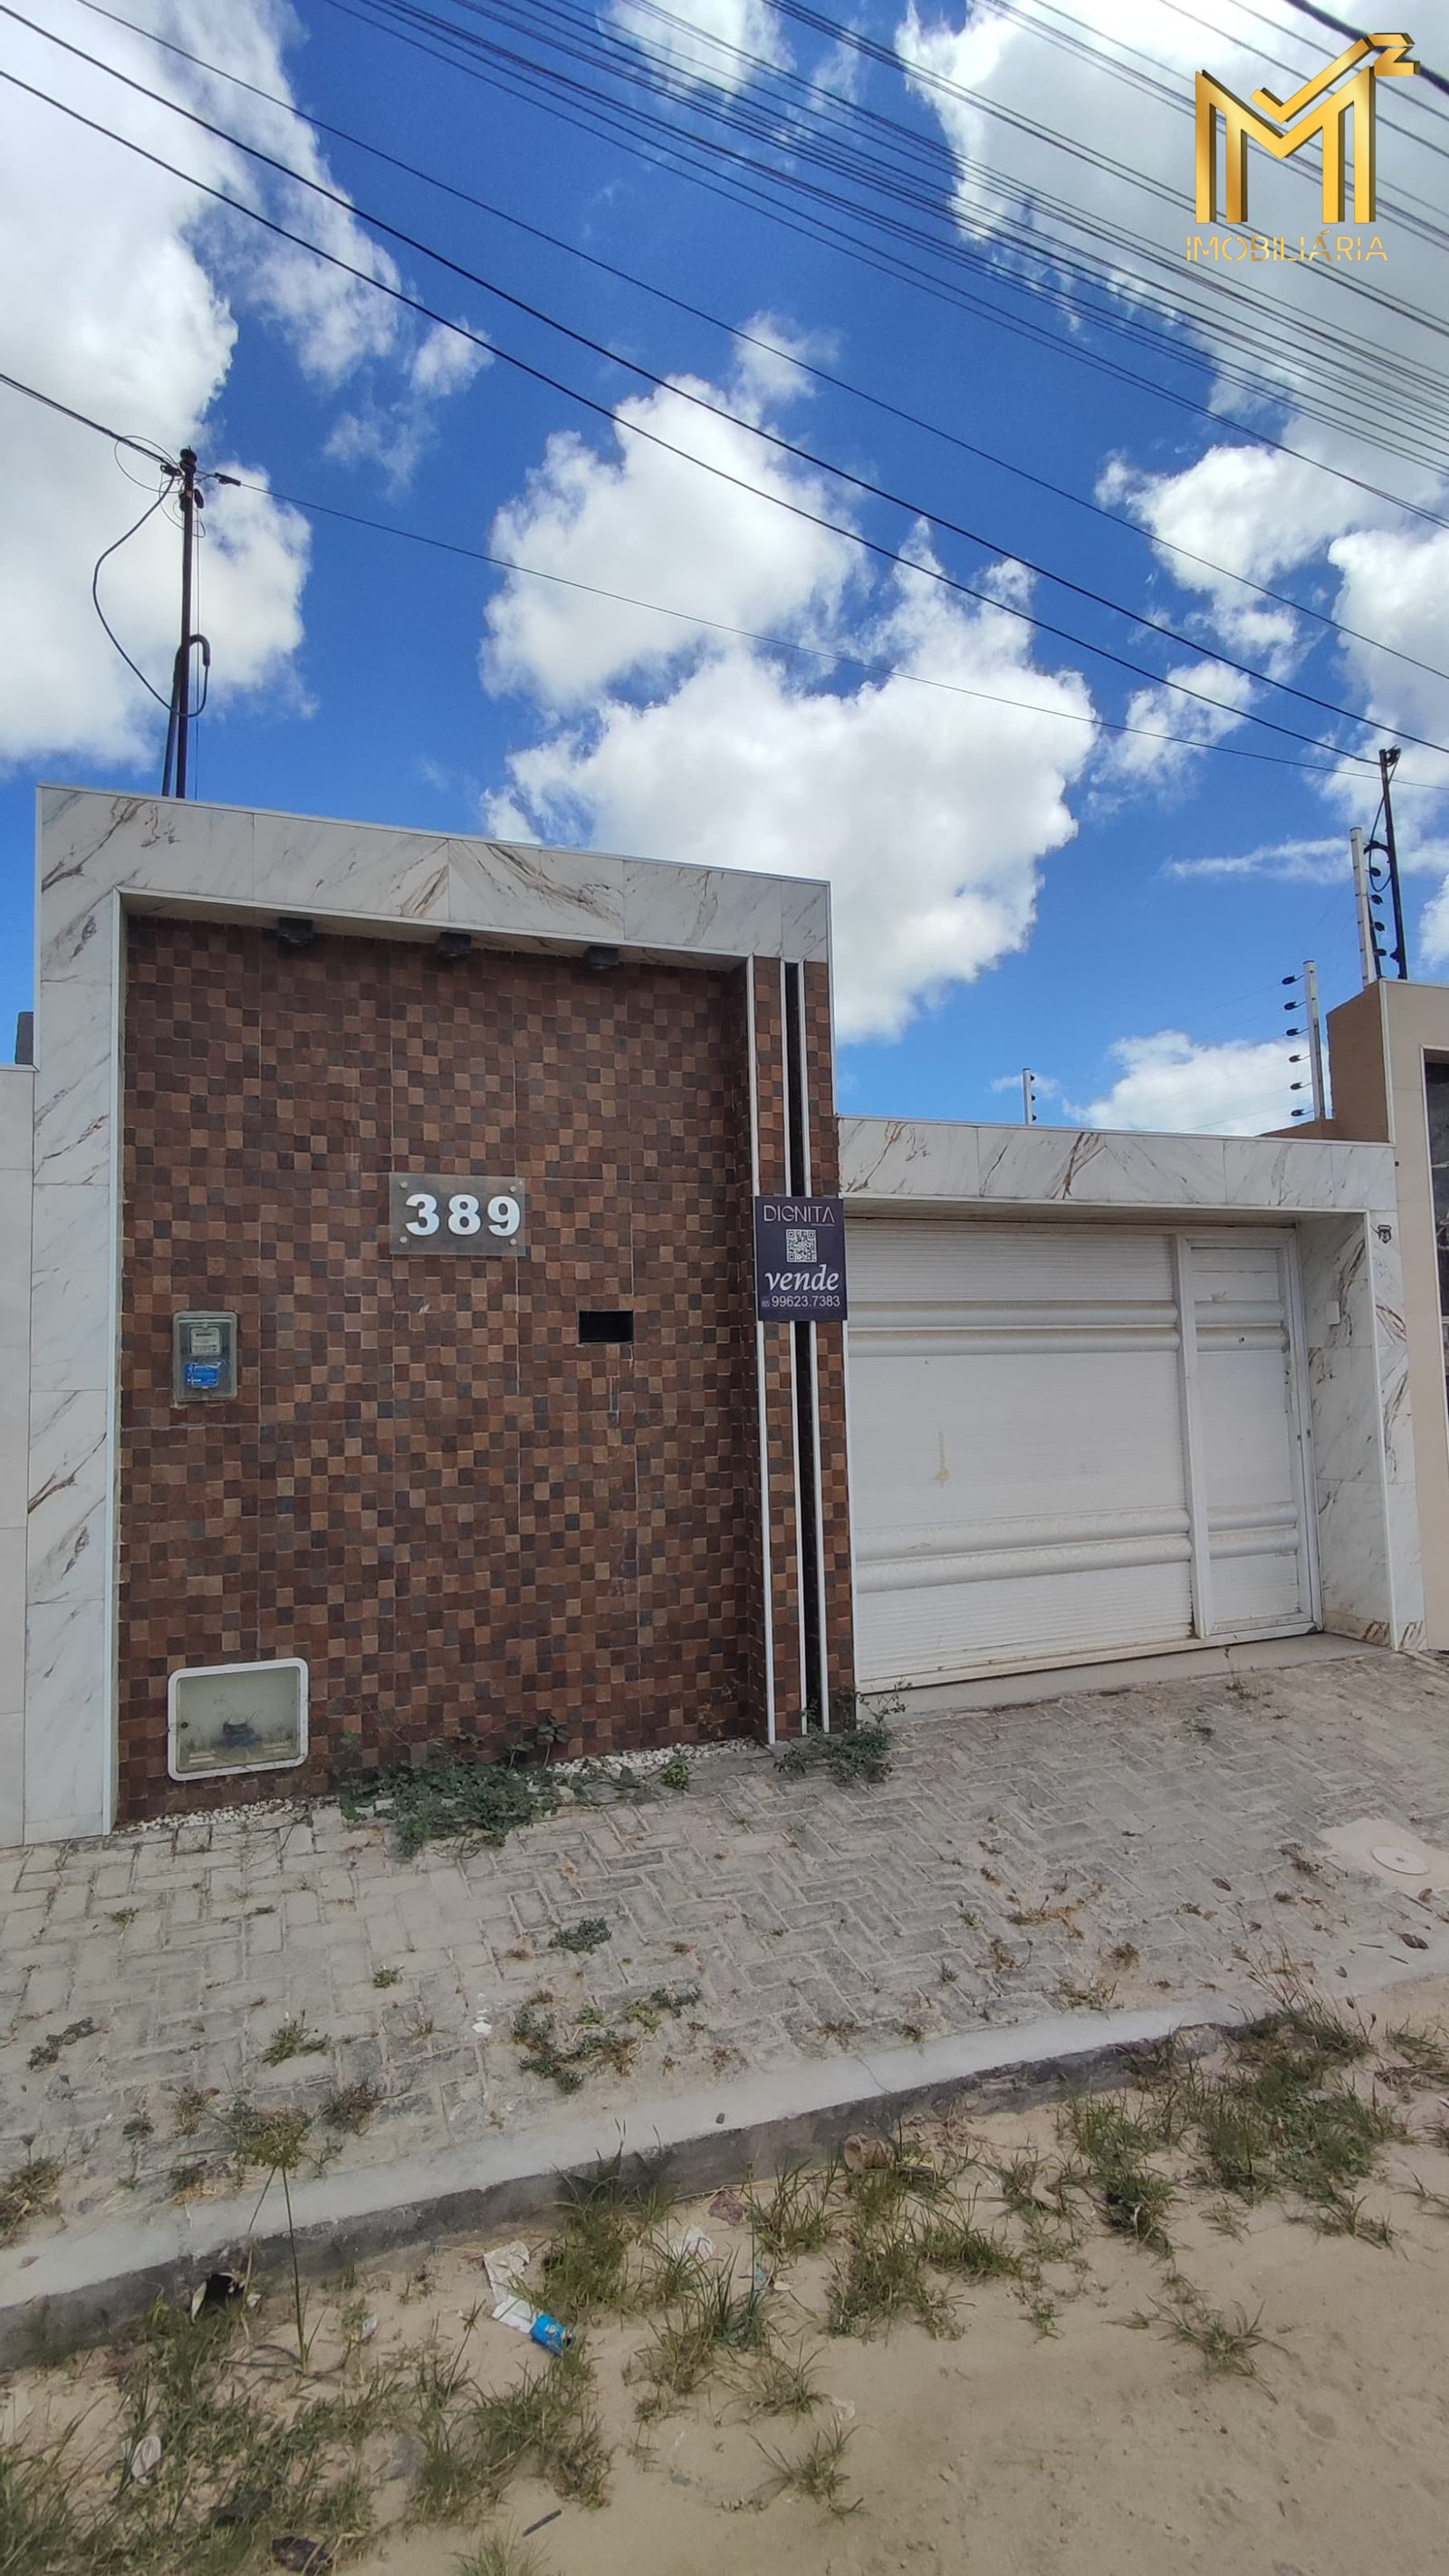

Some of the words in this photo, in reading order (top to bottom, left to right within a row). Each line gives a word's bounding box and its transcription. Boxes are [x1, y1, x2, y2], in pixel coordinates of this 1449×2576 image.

[406, 1194, 521, 1236] 389
[763, 1205, 835, 1224] DIGNITA
[764, 1264, 840, 1292] vende
[772, 1295, 840, 1307] 99623.7383
